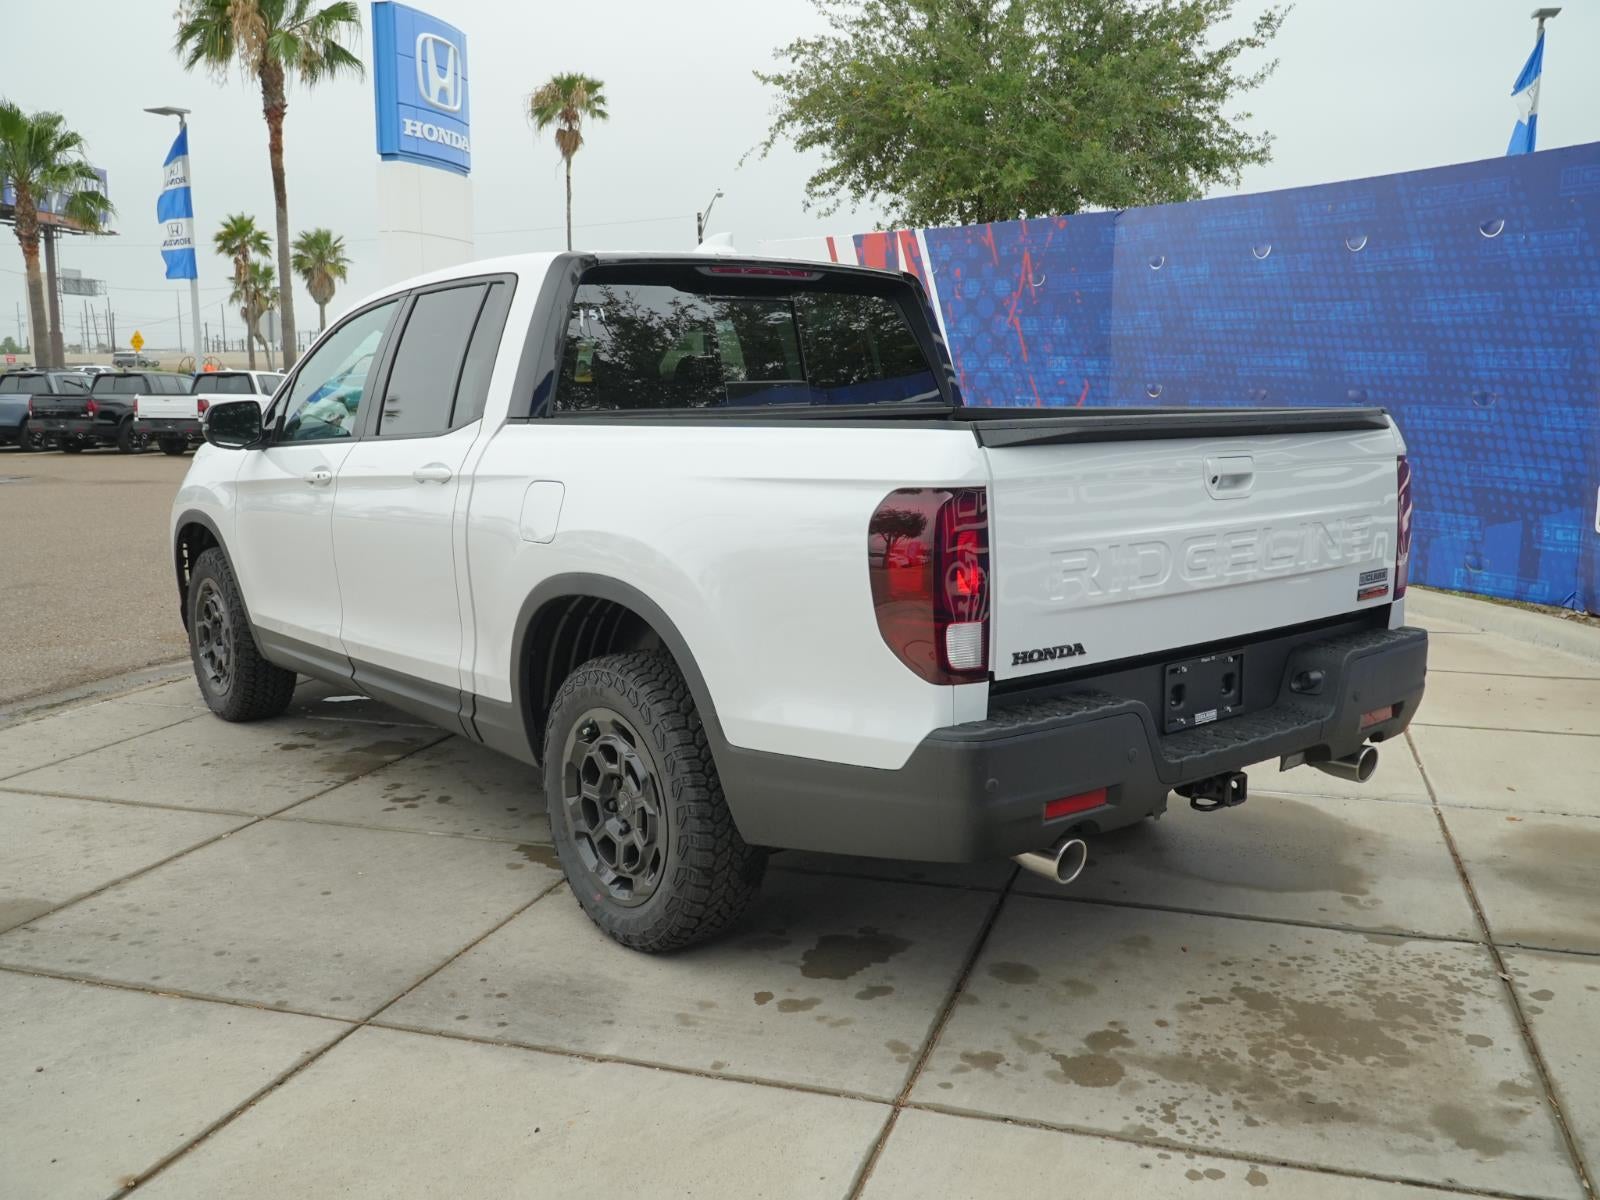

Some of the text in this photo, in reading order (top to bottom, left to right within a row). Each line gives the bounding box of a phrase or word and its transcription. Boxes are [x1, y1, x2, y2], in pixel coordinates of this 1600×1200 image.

[403, 118, 470, 152] HONDA
[1047, 513, 1374, 601] RIDGELINE
[1011, 643, 1087, 666] HONDA
